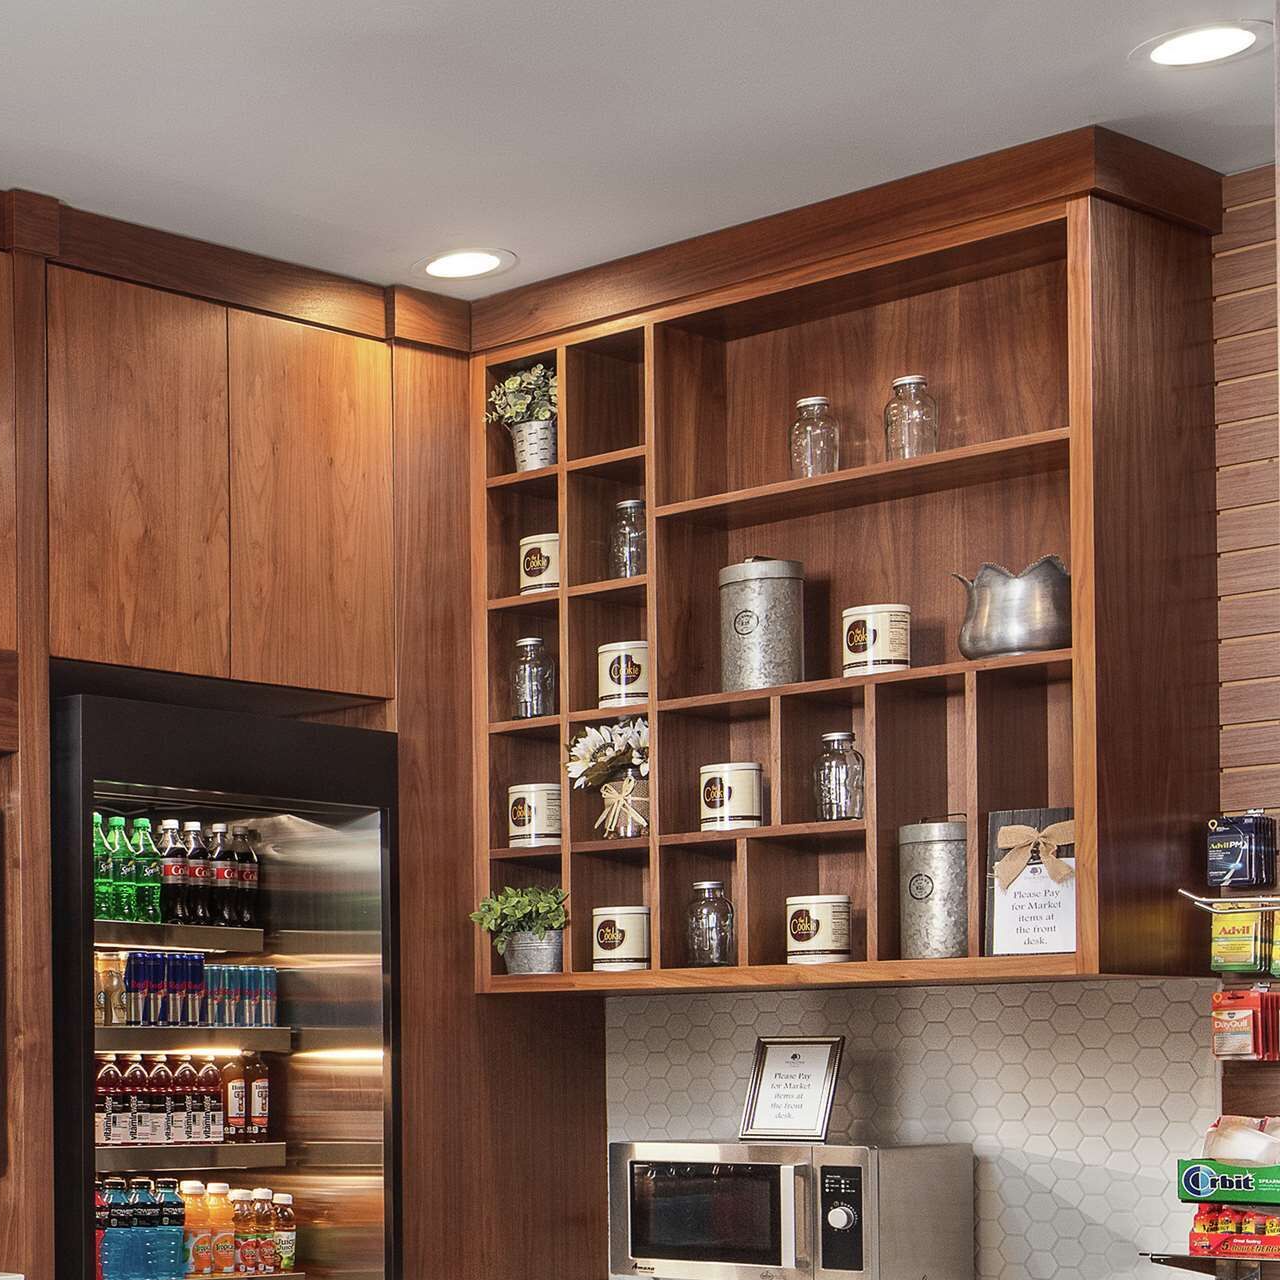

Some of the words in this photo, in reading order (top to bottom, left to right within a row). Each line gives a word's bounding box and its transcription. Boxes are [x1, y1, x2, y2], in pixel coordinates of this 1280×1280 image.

[1014, 891, 1039, 899] Please
[1043, 890, 1061, 900] Pay
[1011, 903, 1023, 911] for
[1026, 901, 1062, 911] Market
[1016, 926, 1030, 934] the
[1219, 926, 1249, 935] Advil
[1215, 1019, 1248, 1029] DayQuil
[1182, 1164, 1256, 1198] Orbit
[632, 1262, 655, 1271] Amana
